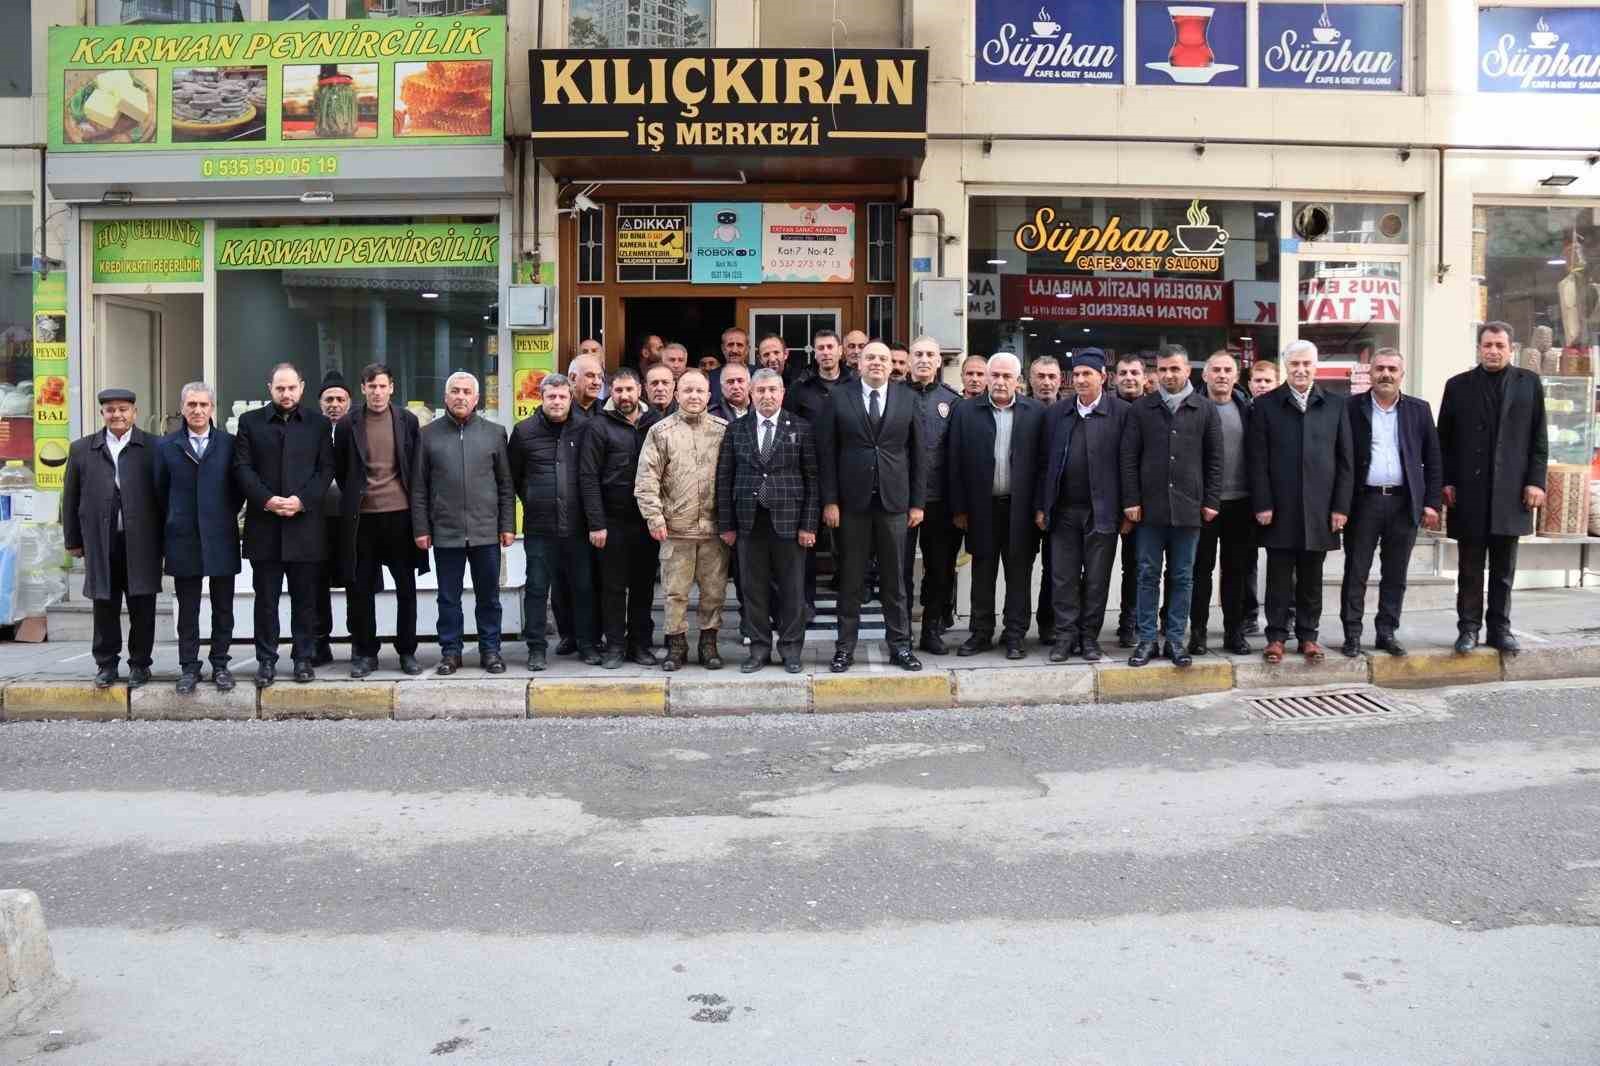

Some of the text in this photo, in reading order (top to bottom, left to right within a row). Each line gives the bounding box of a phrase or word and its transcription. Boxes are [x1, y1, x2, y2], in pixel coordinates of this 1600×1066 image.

[71, 21, 491, 64] KARWAN PEYNİRCİLİK
[983, 23, 1117, 77] Süphan
[1265, 30, 1396, 83] Süphan
[542, 58, 917, 118] KILIÇKIRAN
[1035, 70, 1054, 78] CAFE
[1061, 70, 1080, 78] OKEY
[1084, 71, 1113, 79] SALONU
[636, 116, 820, 152] İŞ MERKEZİ
[203, 157, 337, 176] 0 535 590 05 19
[219, 227, 499, 265] KARWAN PEYNİRCİLİK
[1015, 207, 1173, 263] Süphan
[1077, 256, 1220, 272] CAFE & OKEY SALONU
[38, 411, 67, 421] BAL
